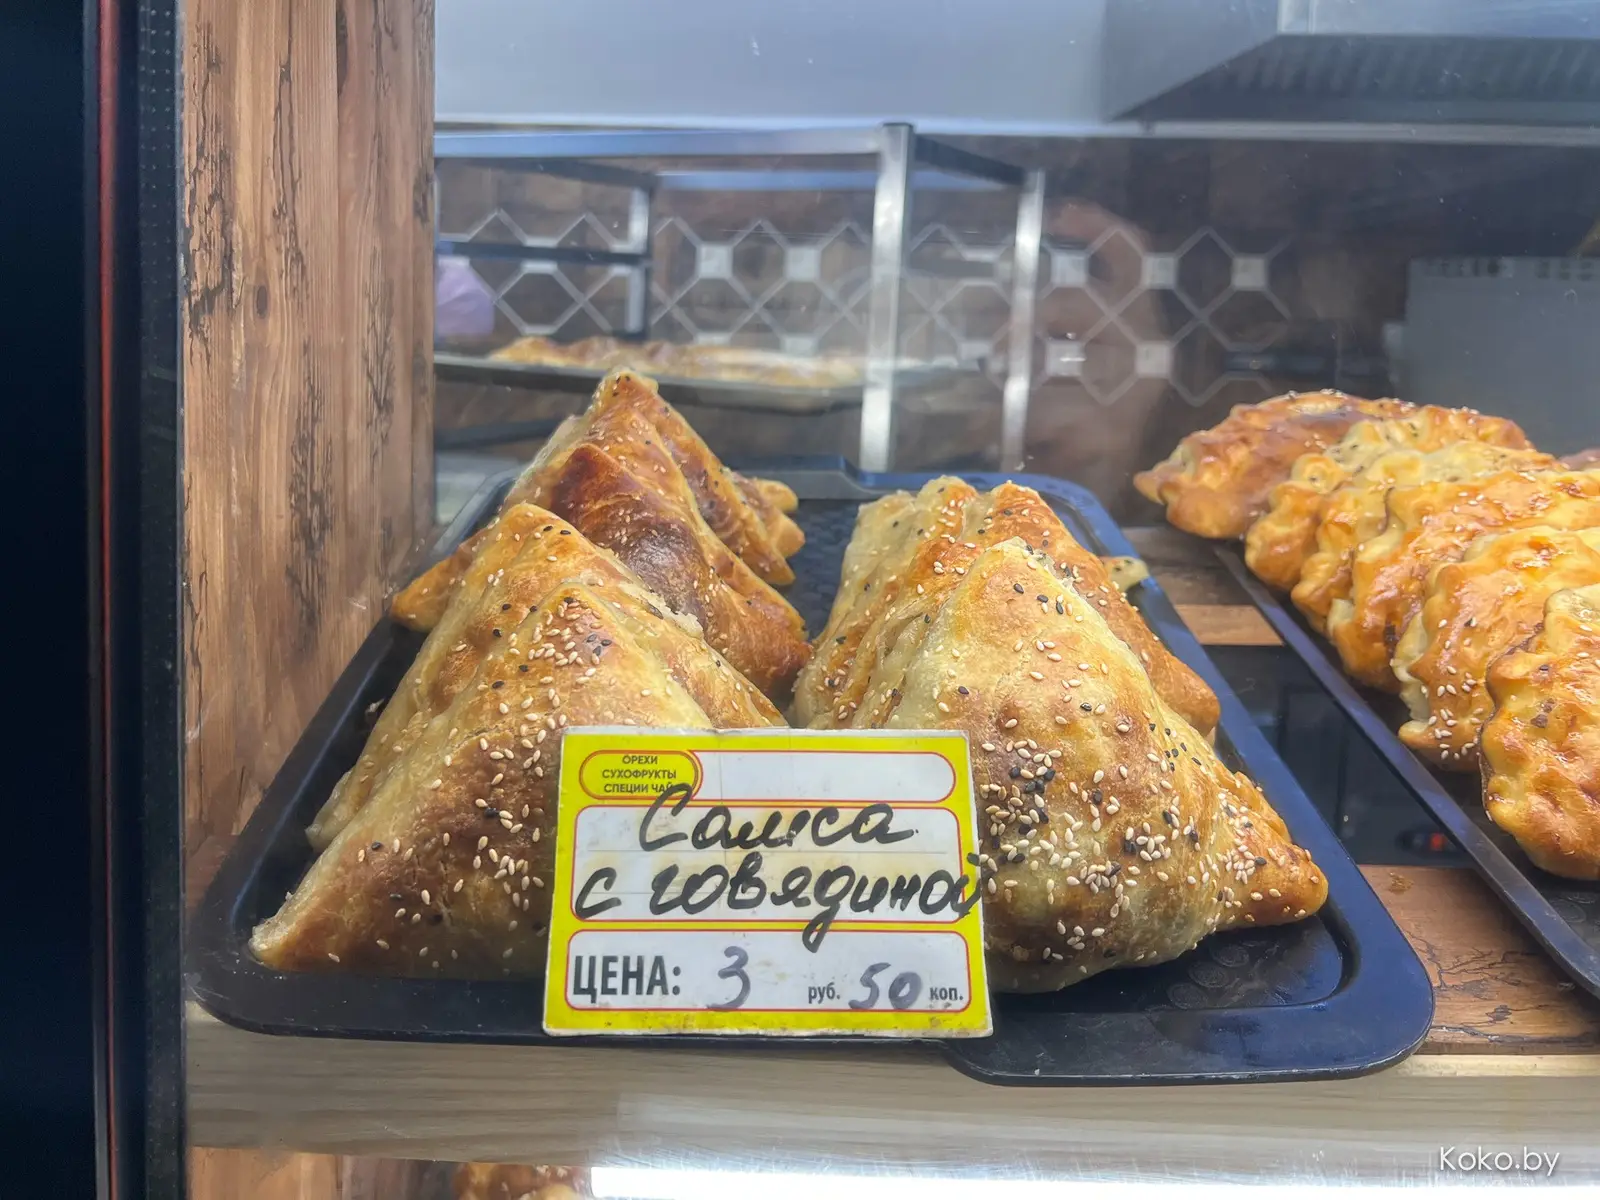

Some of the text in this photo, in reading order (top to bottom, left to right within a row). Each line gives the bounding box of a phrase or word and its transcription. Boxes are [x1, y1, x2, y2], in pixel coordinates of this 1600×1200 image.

[601, 769, 677, 780] СУХОФРУКТЫ
[622, 754, 658, 765] ОРЕХИ
[603, 782, 649, 794] СПЕЦИИ
[639, 783, 915, 852] Самса
[576, 851, 981, 953] с говядиной
[573, 946, 964, 1009] ЦЕНА: 3 руб. 50 коп.
